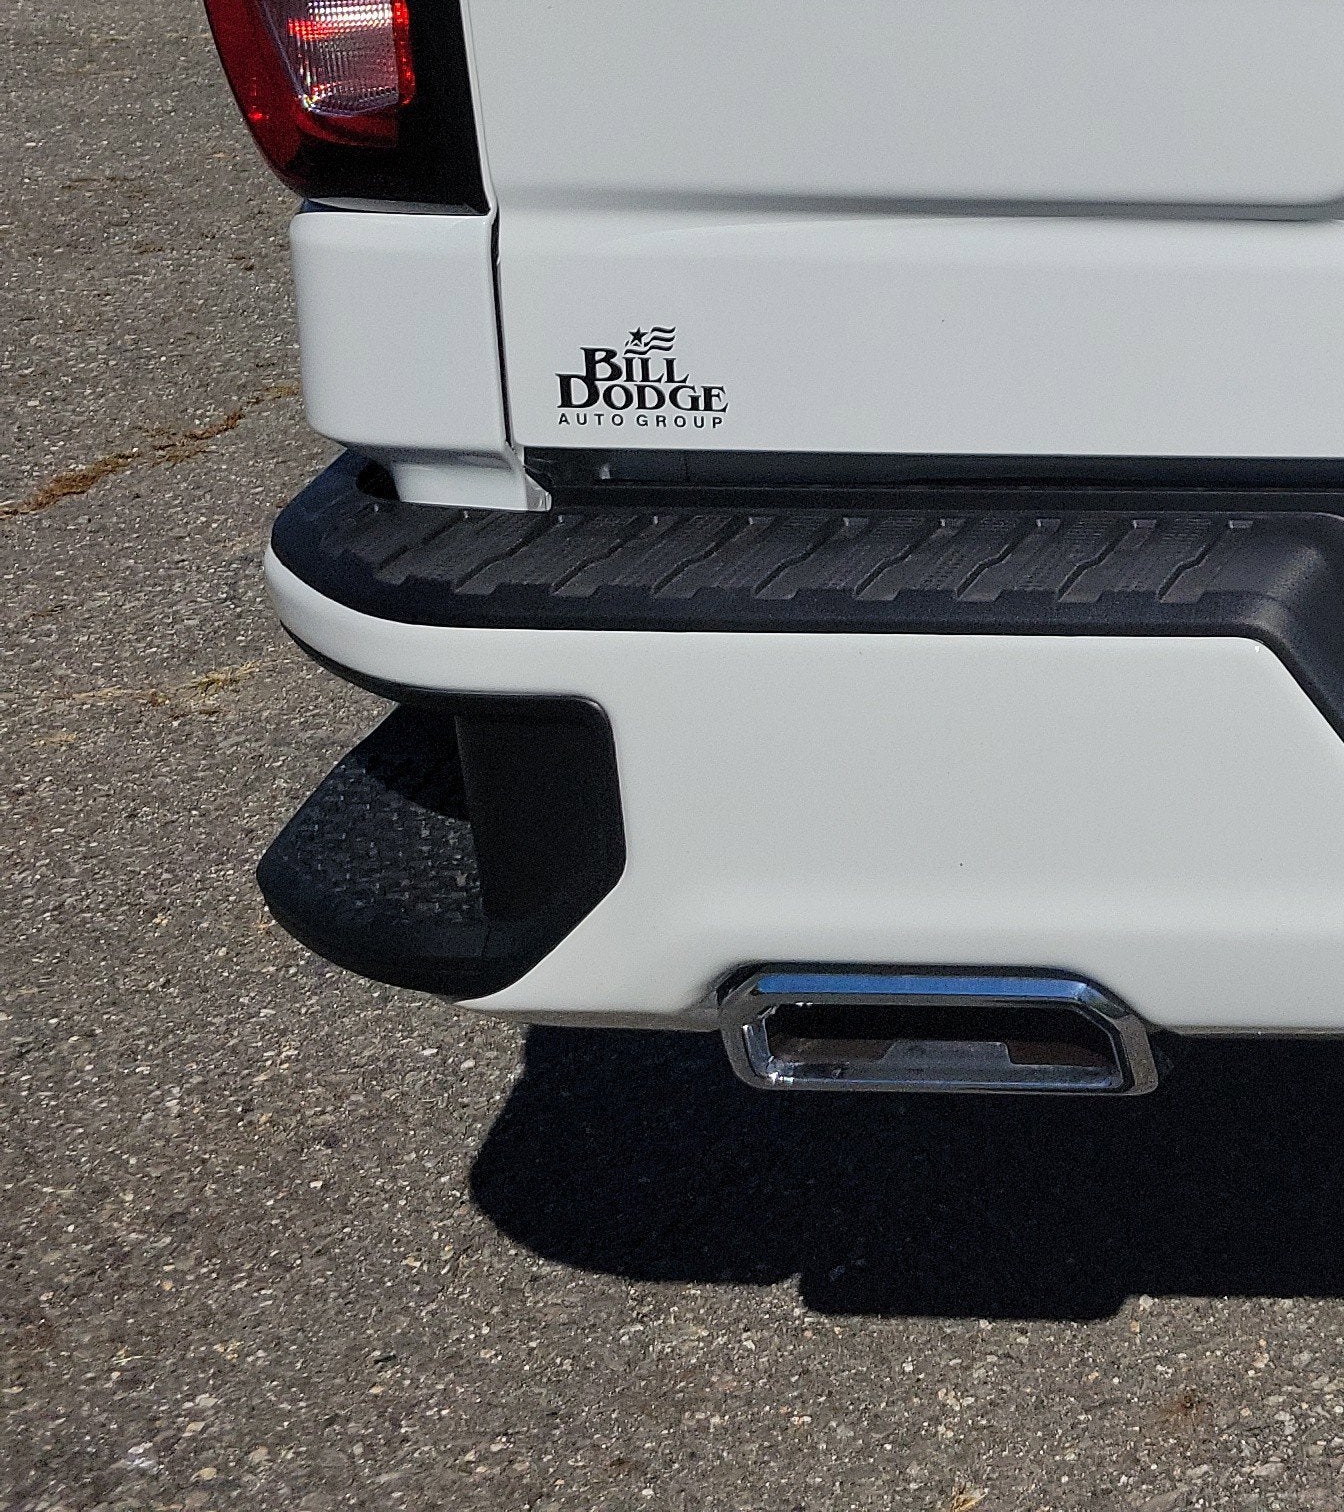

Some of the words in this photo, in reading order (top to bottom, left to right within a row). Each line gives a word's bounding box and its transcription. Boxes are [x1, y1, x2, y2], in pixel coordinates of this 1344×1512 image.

[579, 346, 689, 384] BILL
[555, 372, 729, 413] DODGE
[558, 412, 624, 427] AUTO
[636, 414, 723, 429] GROUP
